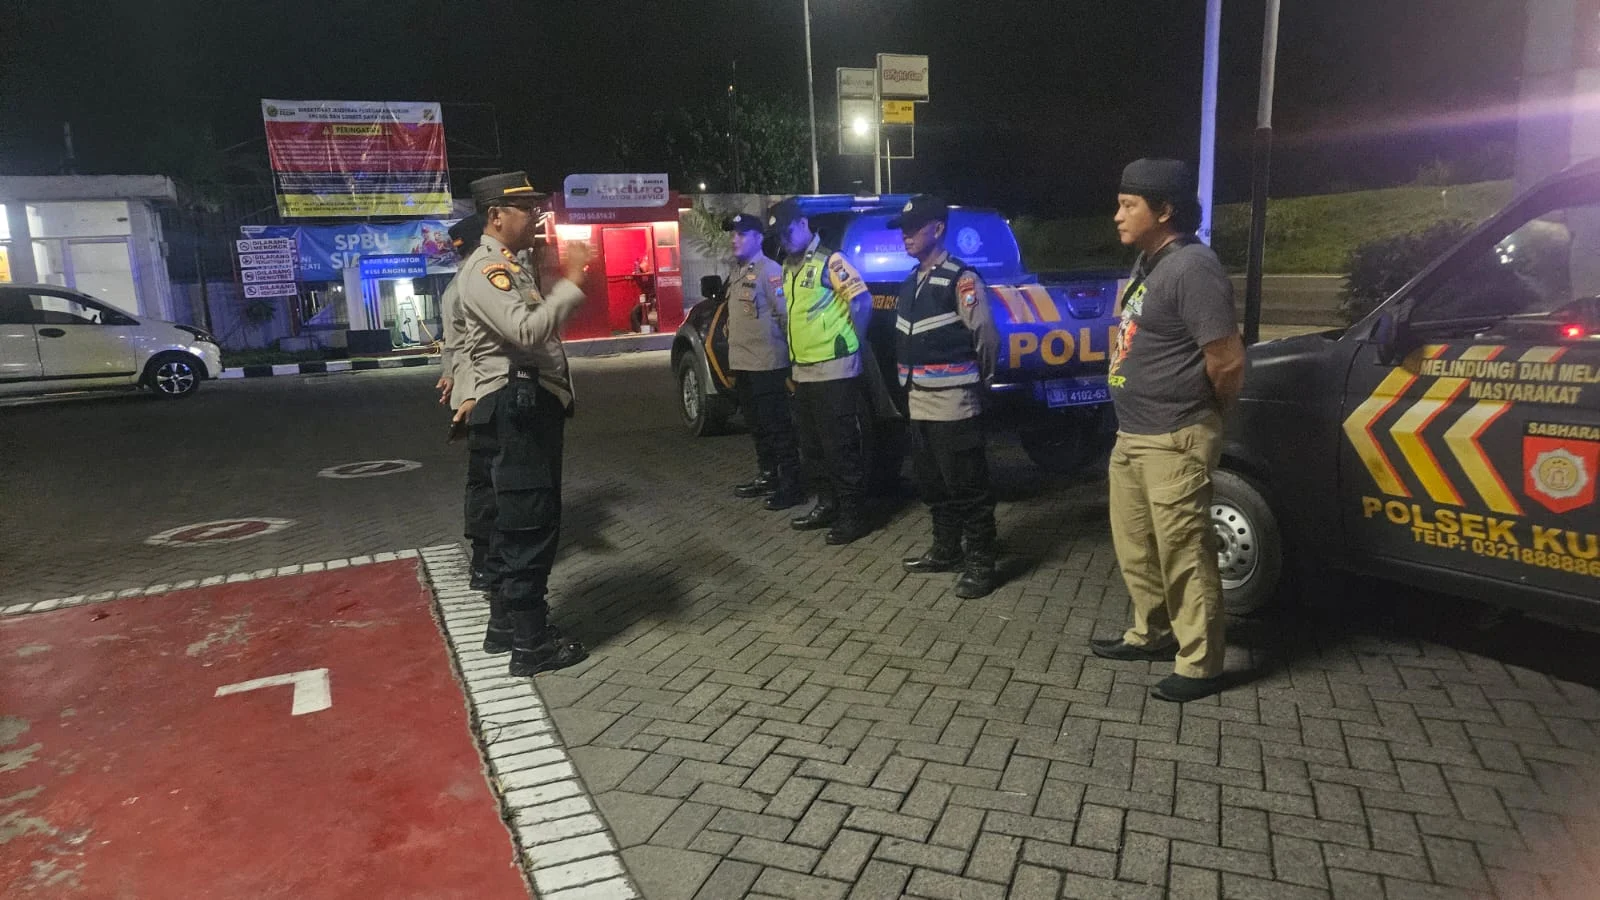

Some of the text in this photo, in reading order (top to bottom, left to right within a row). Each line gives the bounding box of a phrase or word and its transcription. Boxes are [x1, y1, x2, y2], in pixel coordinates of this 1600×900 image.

[334, 233, 389, 250] SPBU
[1009, 327, 1120, 369] POLI
[1420, 359, 1516, 380] MELINDUNGI
[1519, 362, 1556, 381] DAN
[1469, 382, 1582, 404] MASYARAKAT
[1527, 421, 1600, 440] SABHARA
[1362, 495, 1600, 560] POLSEK KU
[1411, 527, 1466, 549] TELP:
